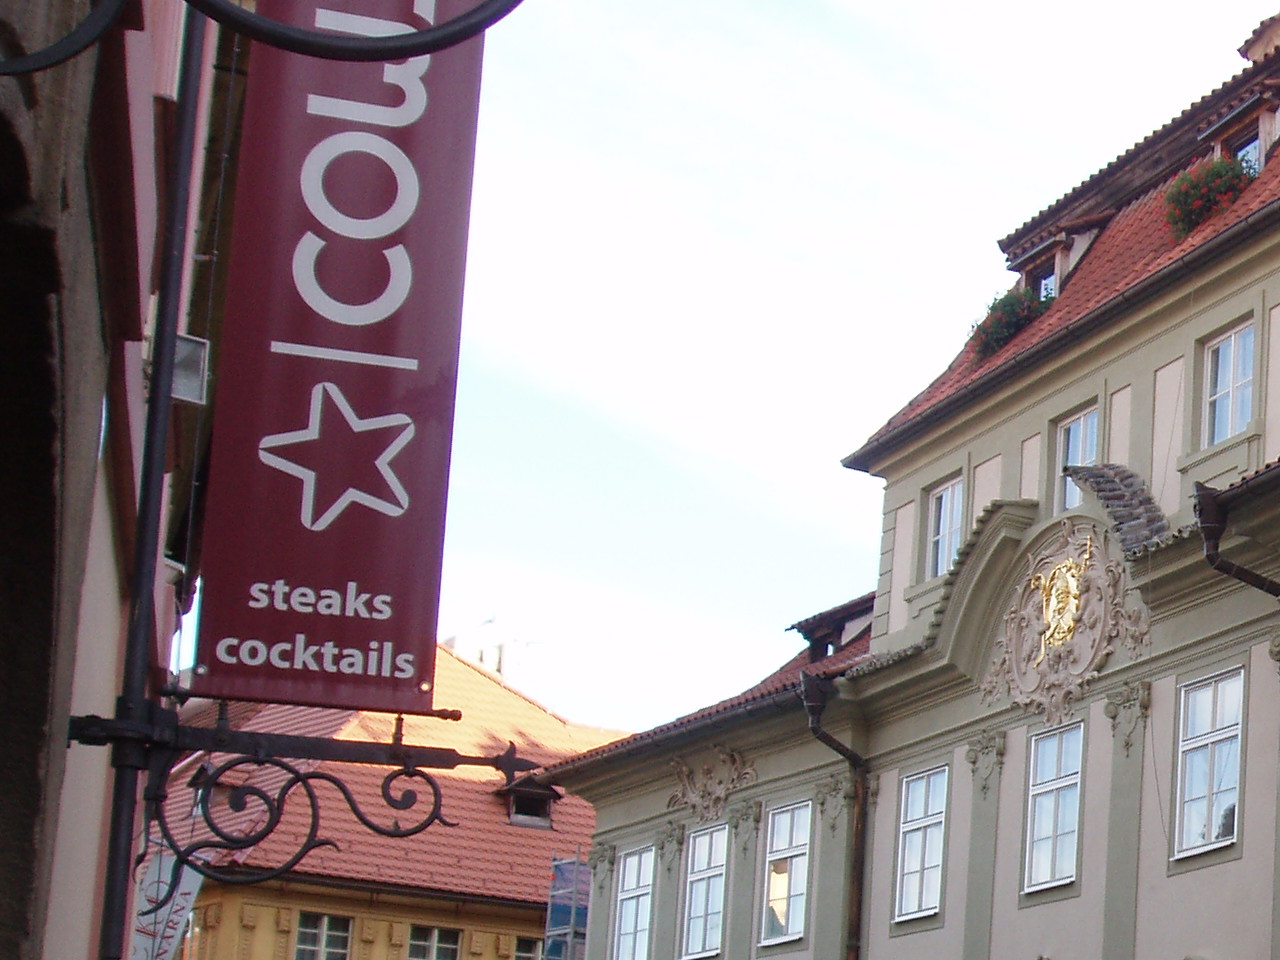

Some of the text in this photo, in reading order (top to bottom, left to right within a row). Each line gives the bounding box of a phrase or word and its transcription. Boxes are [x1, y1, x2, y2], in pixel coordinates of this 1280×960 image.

[291, 0, 436, 326] cow
[248, 579, 393, 621] steaks
[215, 632, 416, 680] cocktails
